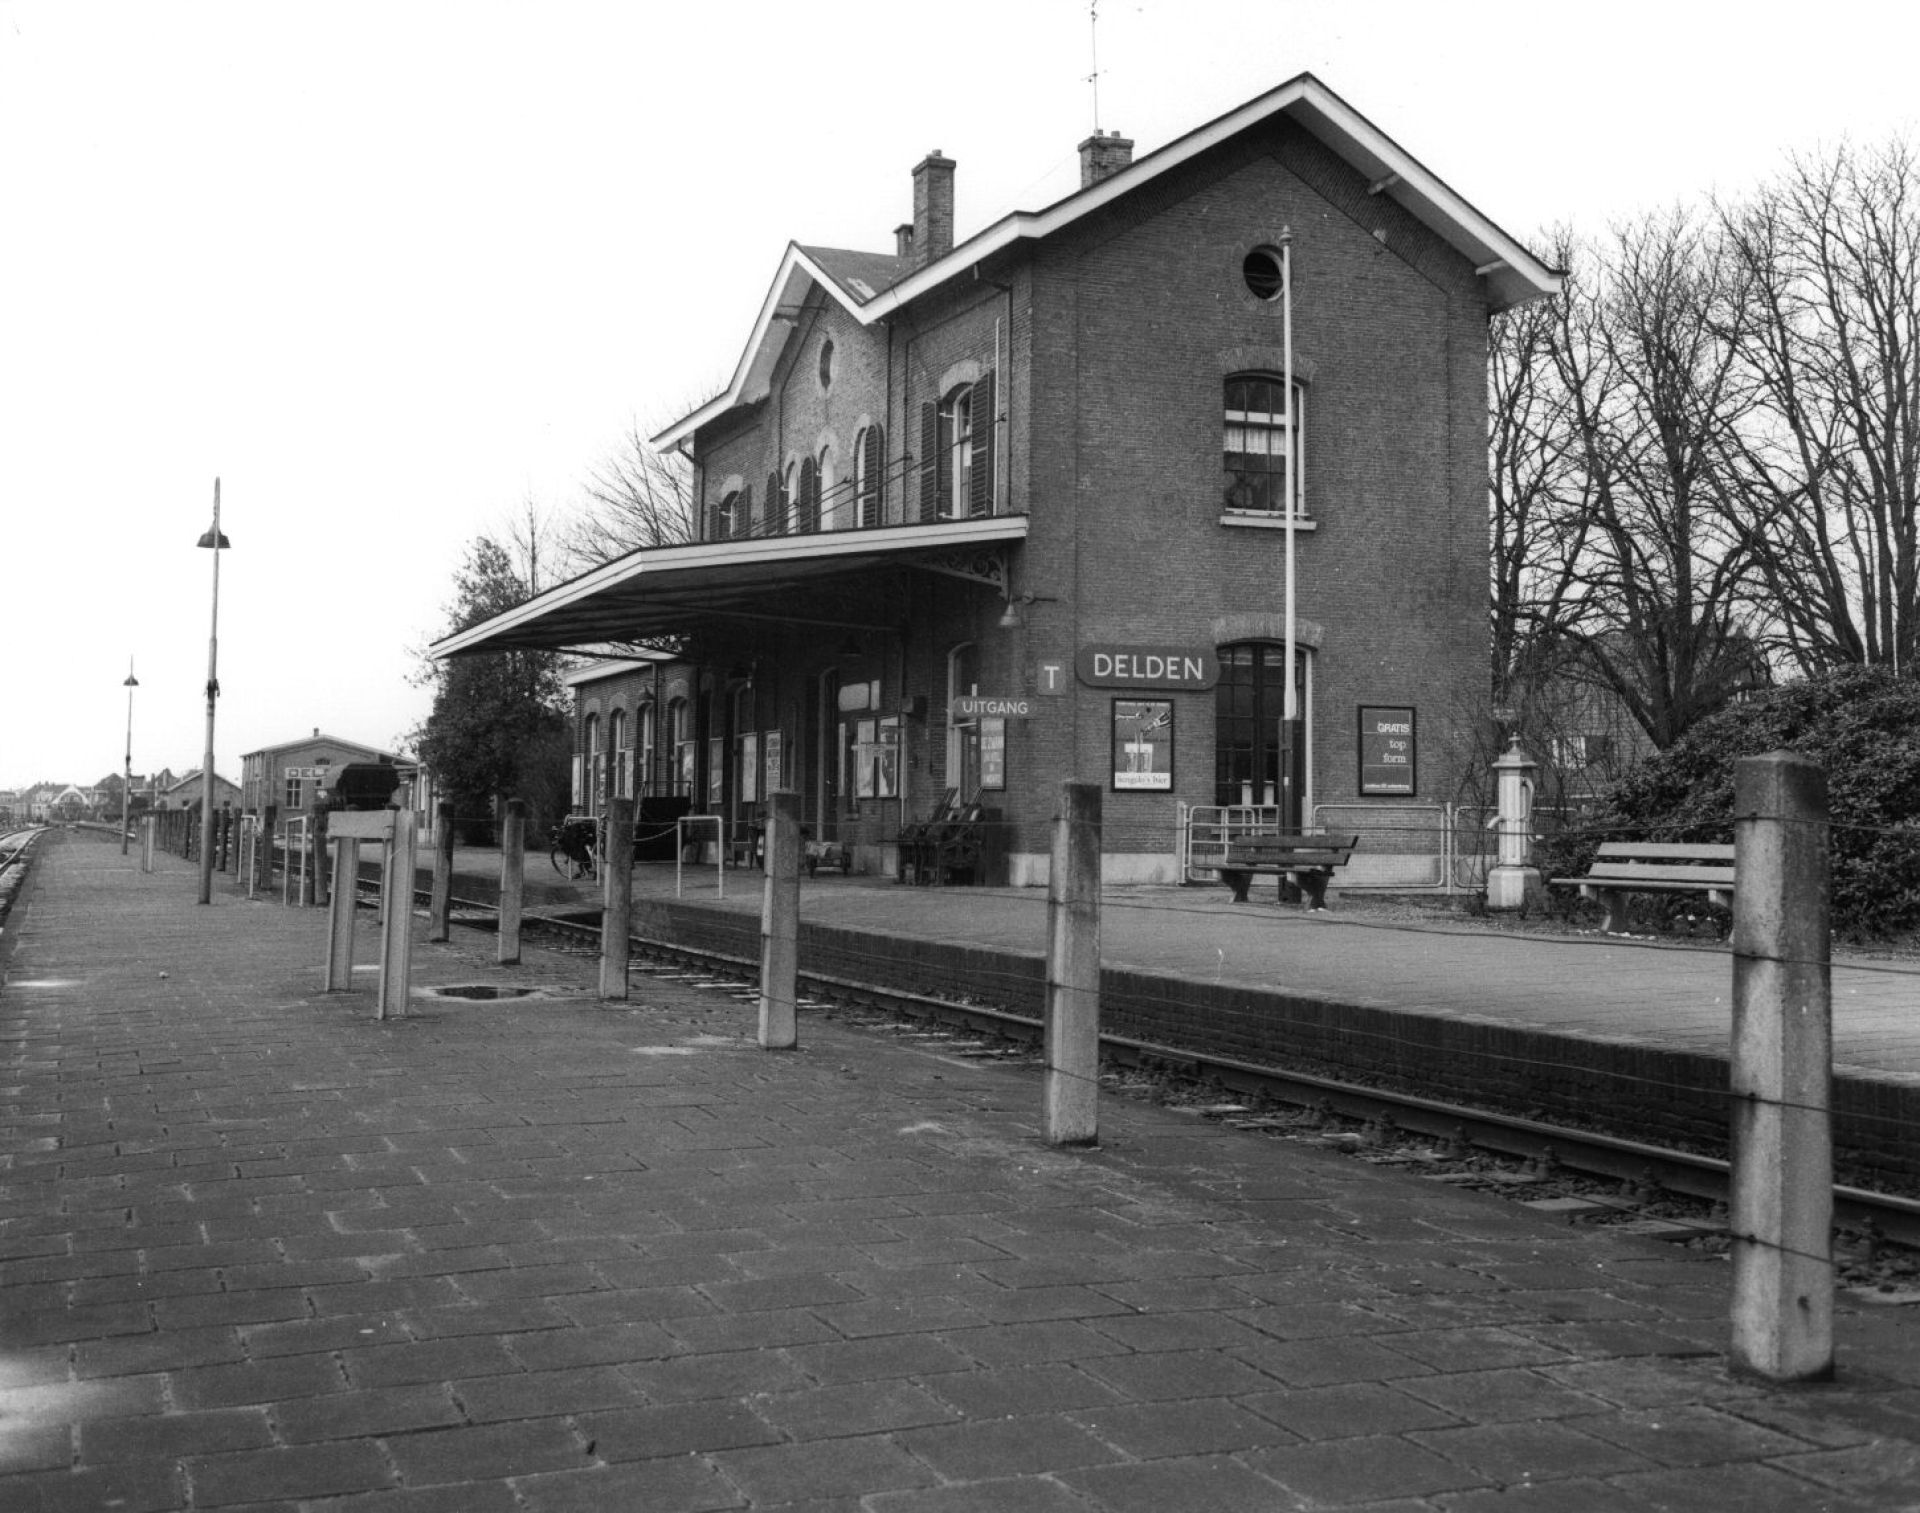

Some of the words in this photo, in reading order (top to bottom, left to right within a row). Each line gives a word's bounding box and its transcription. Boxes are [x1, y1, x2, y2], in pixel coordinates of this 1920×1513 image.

[1094, 653, 1203, 680] DELDEN
[1044, 665, 1059, 689] T
[963, 701, 1028, 715] UITGANG
[1377, 723, 1410, 733] GRATIS
